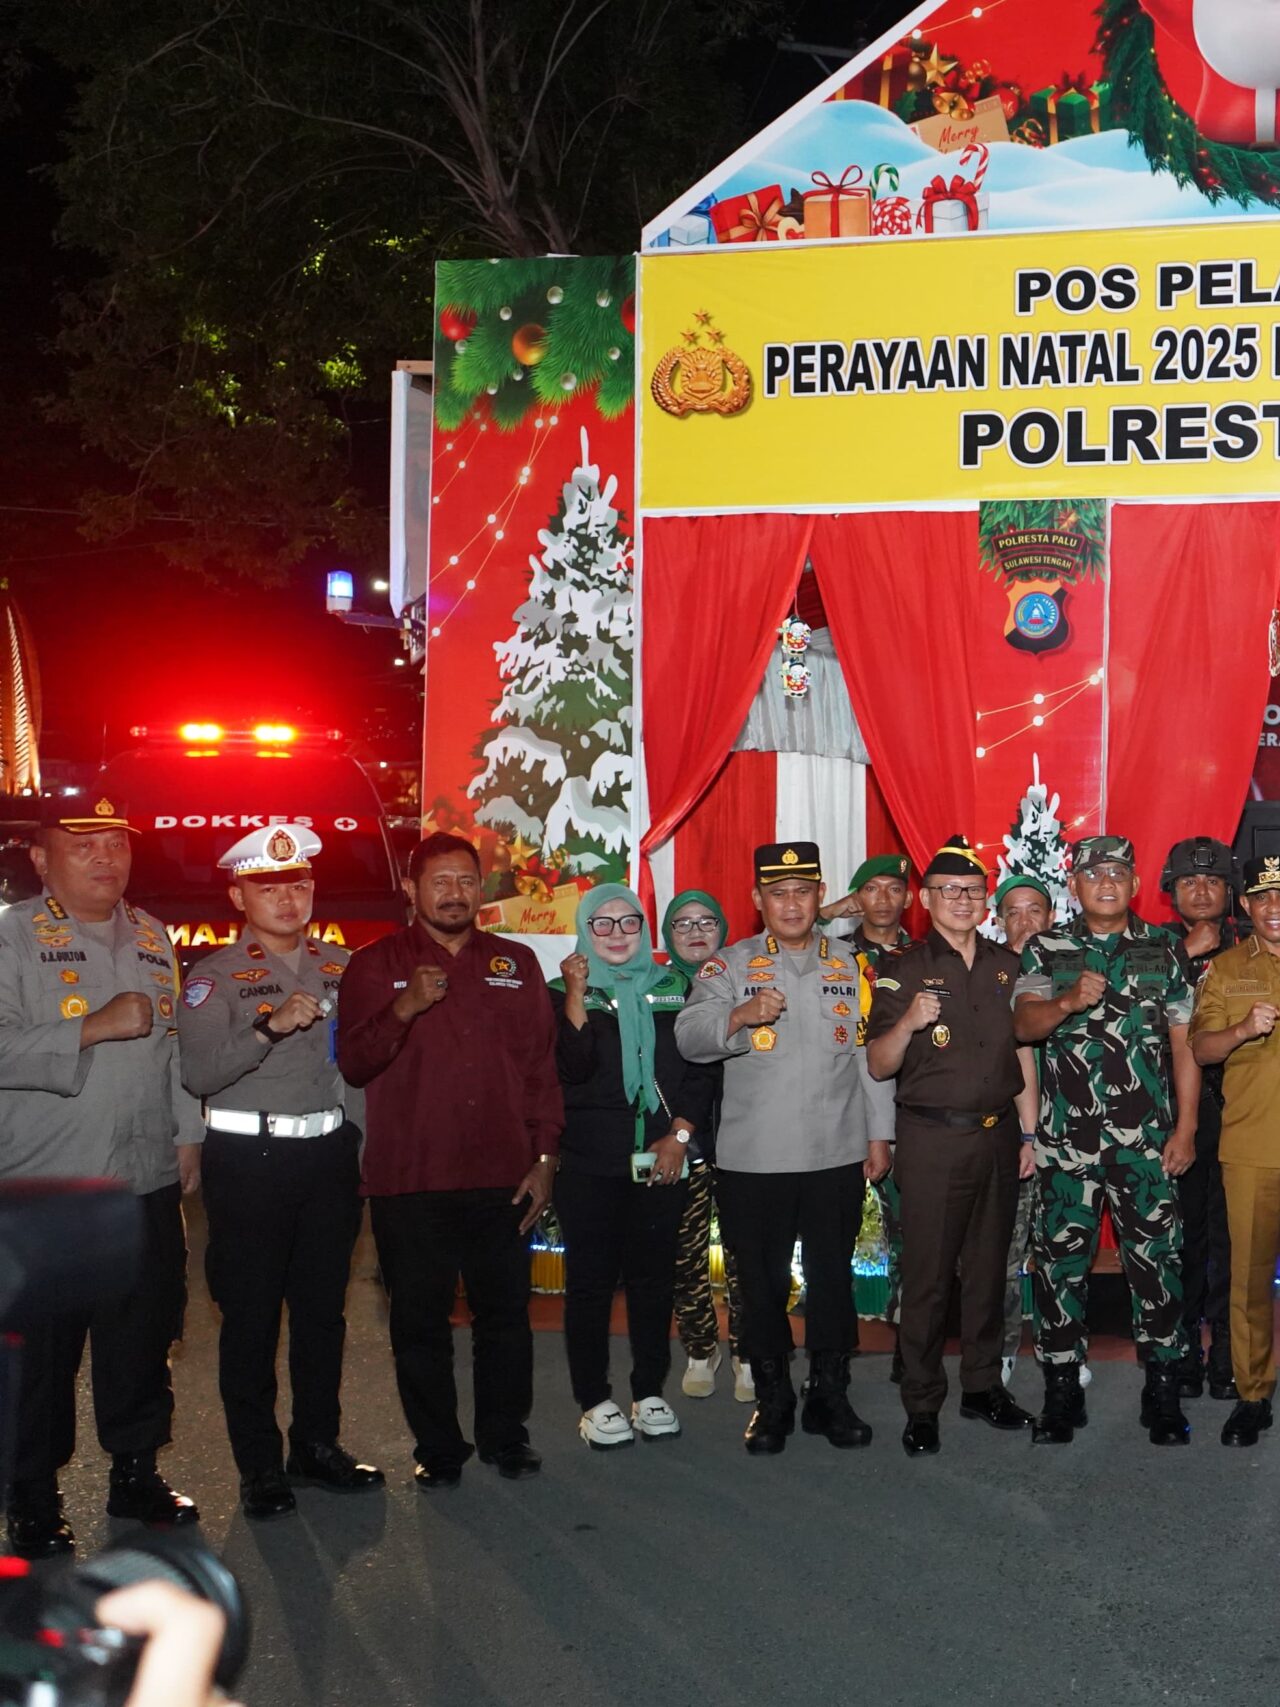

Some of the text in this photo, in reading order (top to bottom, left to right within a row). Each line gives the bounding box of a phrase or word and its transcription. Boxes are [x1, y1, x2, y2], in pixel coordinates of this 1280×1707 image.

[938, 125, 979, 149] Merry
[1018, 269, 1136, 313] POS
[766, 338, 985, 394] PERAYAAN
[1003, 332, 1139, 387] NATAL
[1154, 328, 1257, 381] 2025
[999, 533, 1078, 549] POLRESTA PALU
[1003, 555, 1073, 570] SULAWESI TENGAH
[154, 815, 314, 829] DOKKES
[519, 907, 557, 926] Merry
[239, 984, 284, 998] CANDRA
[822, 986, 856, 997] POLRI
